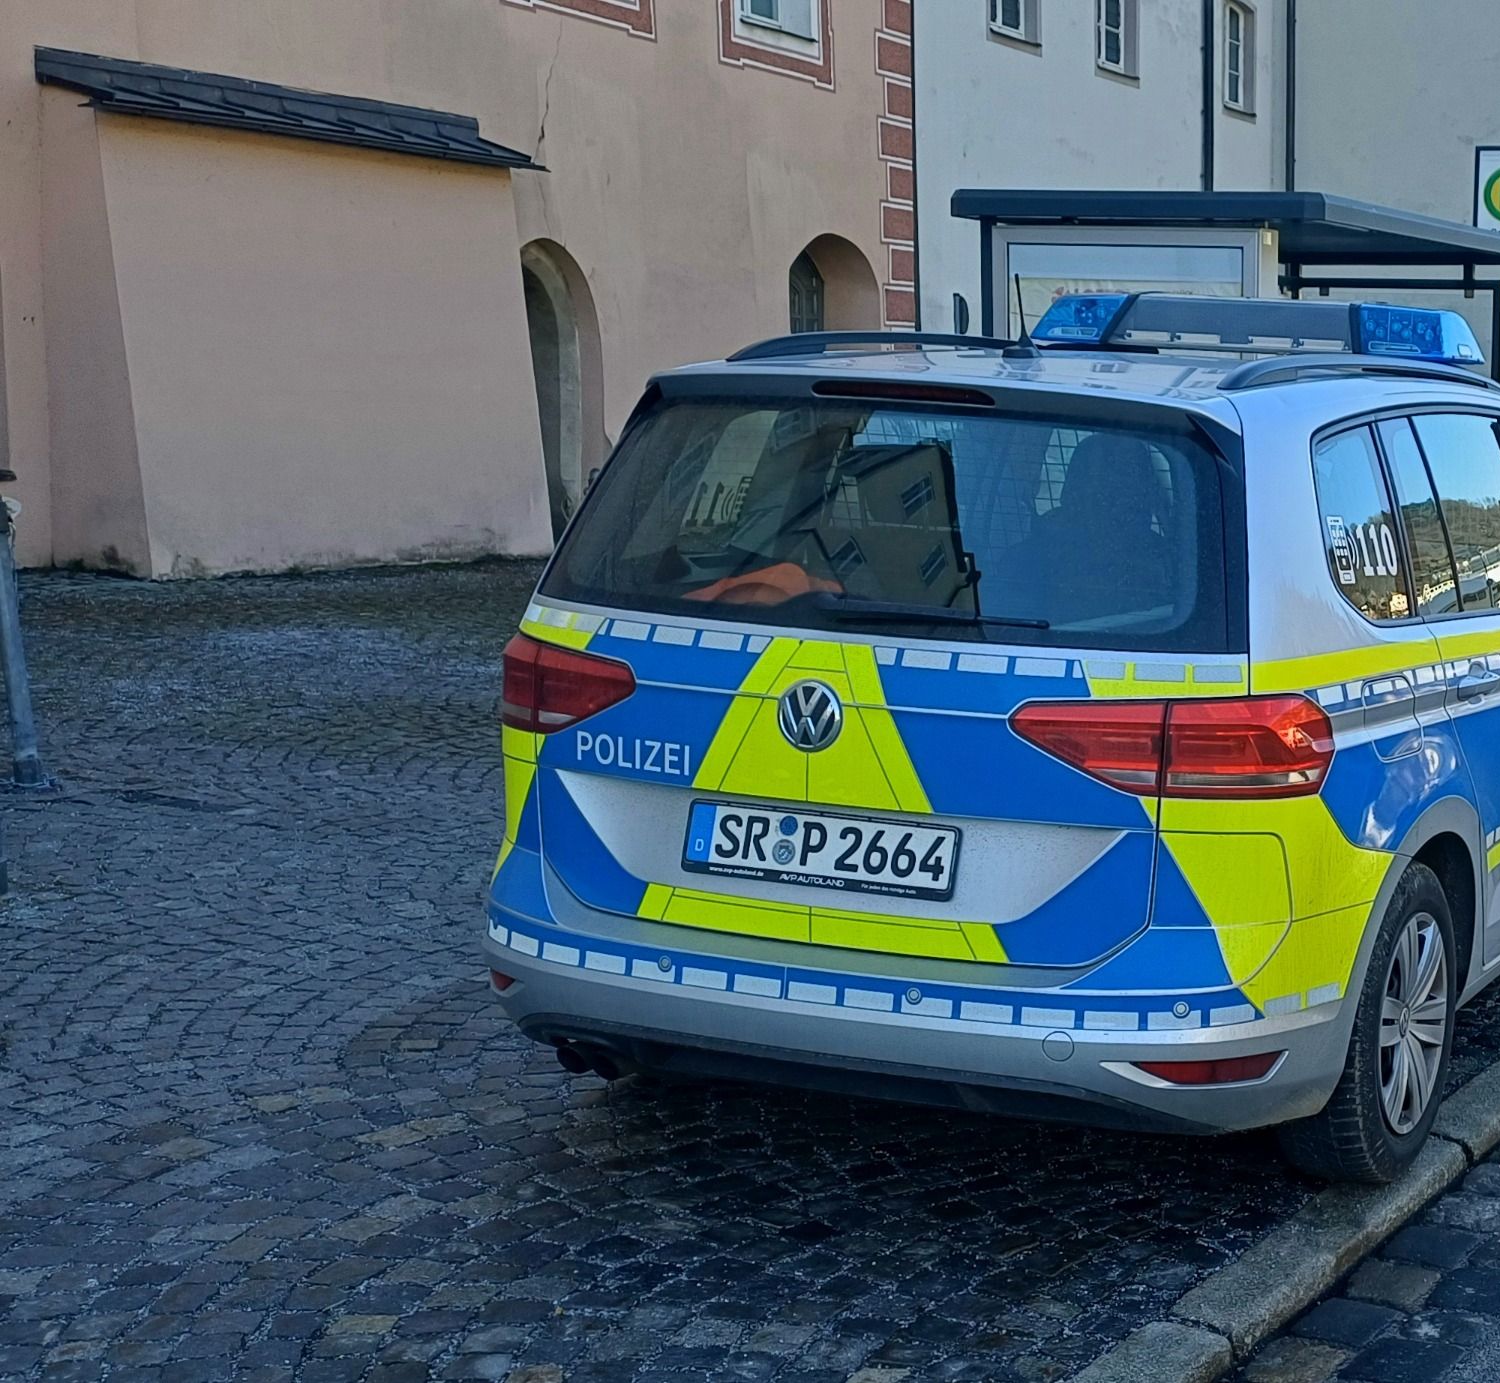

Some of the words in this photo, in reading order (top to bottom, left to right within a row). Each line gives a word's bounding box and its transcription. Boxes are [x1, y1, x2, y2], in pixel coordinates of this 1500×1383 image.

[1356, 524, 1398, 577] 110
[576, 730, 690, 776] POLIZEI
[694, 838, 704, 853] D
[714, 813, 771, 862] SR
[799, 820, 828, 867] P
[833, 826, 947, 882] 2664
[779, 873, 798, 883] AVP
[797, 875, 845, 888] AUTOLAND
